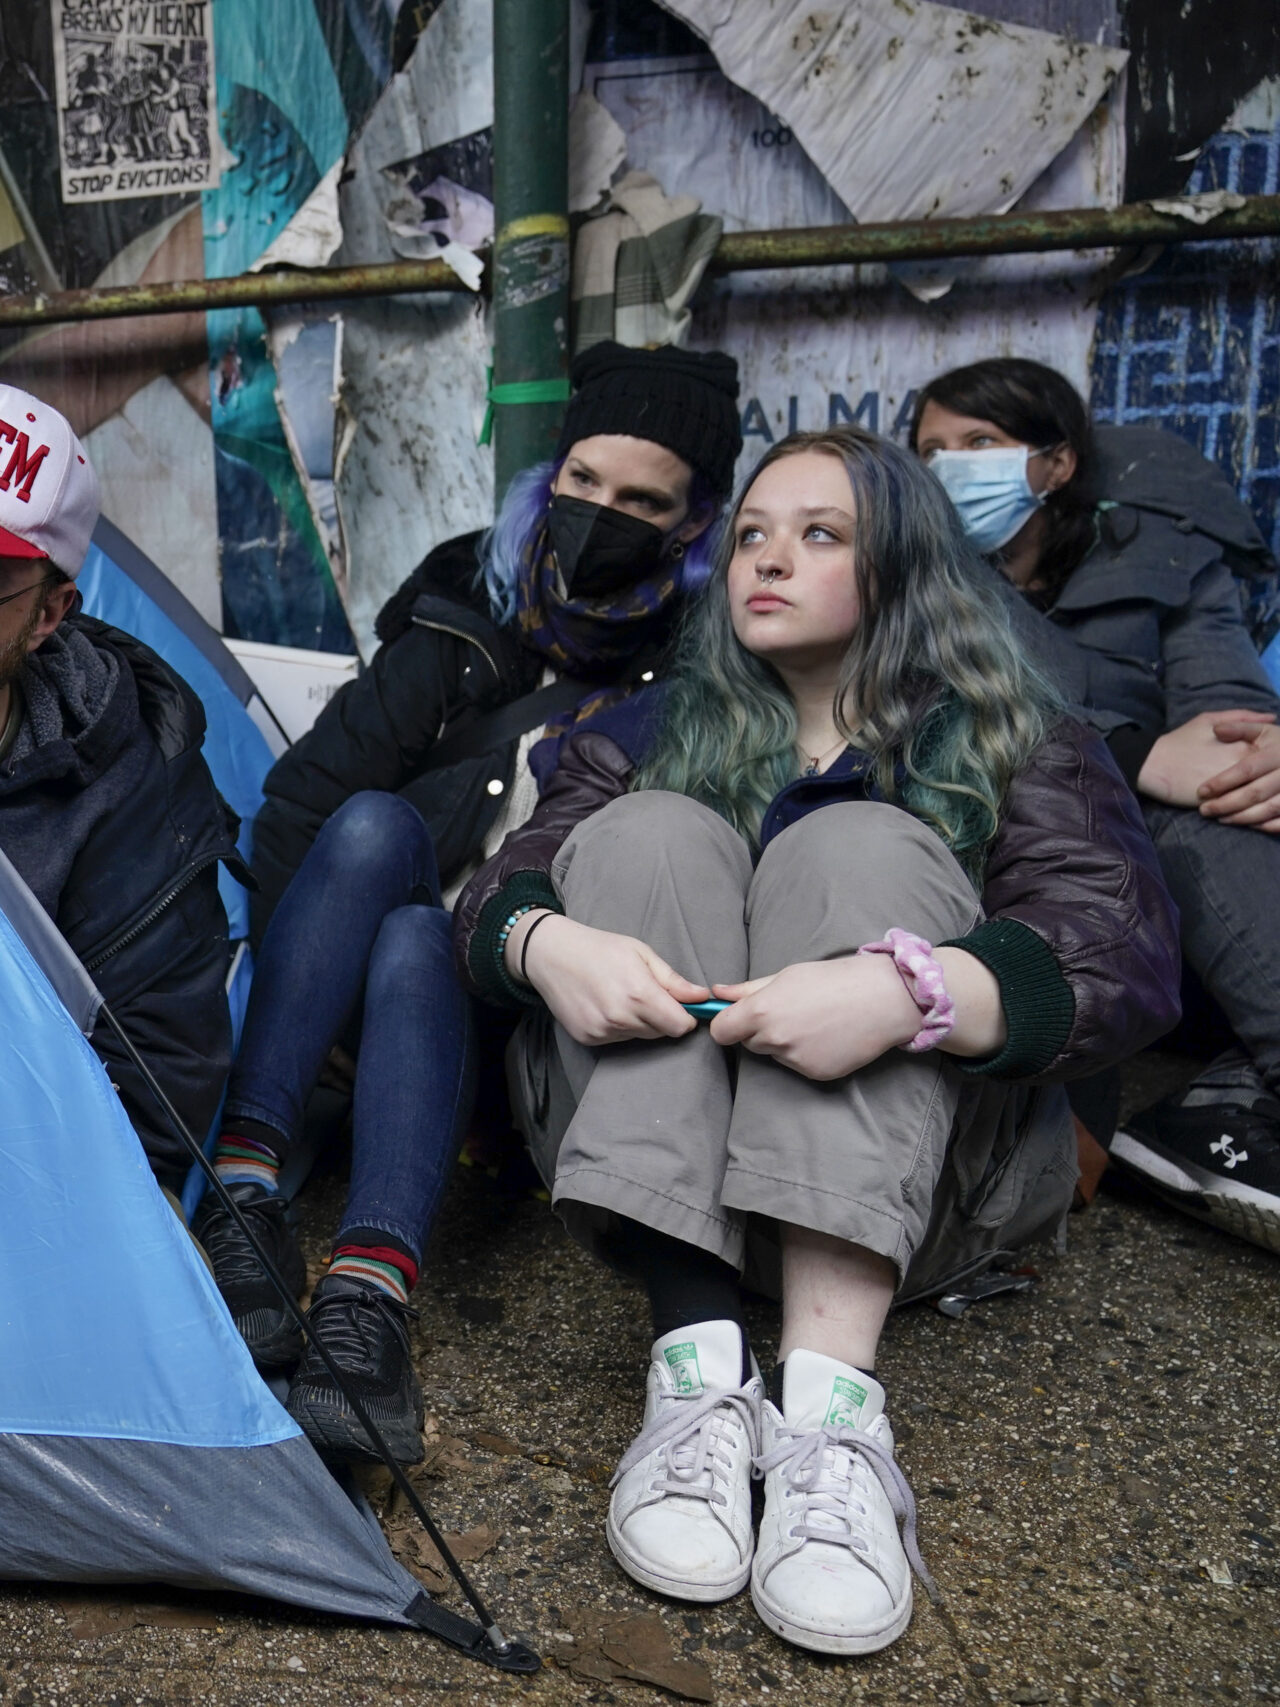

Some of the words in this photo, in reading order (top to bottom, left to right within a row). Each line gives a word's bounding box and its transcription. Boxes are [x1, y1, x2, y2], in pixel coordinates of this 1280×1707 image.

[61, 8, 123, 32] BREAKS
[127, 5, 150, 34] MY
[153, 2, 208, 36] HEART
[67, 174, 113, 195] STOP
[117, 164, 210, 191] EVICTIONS!
